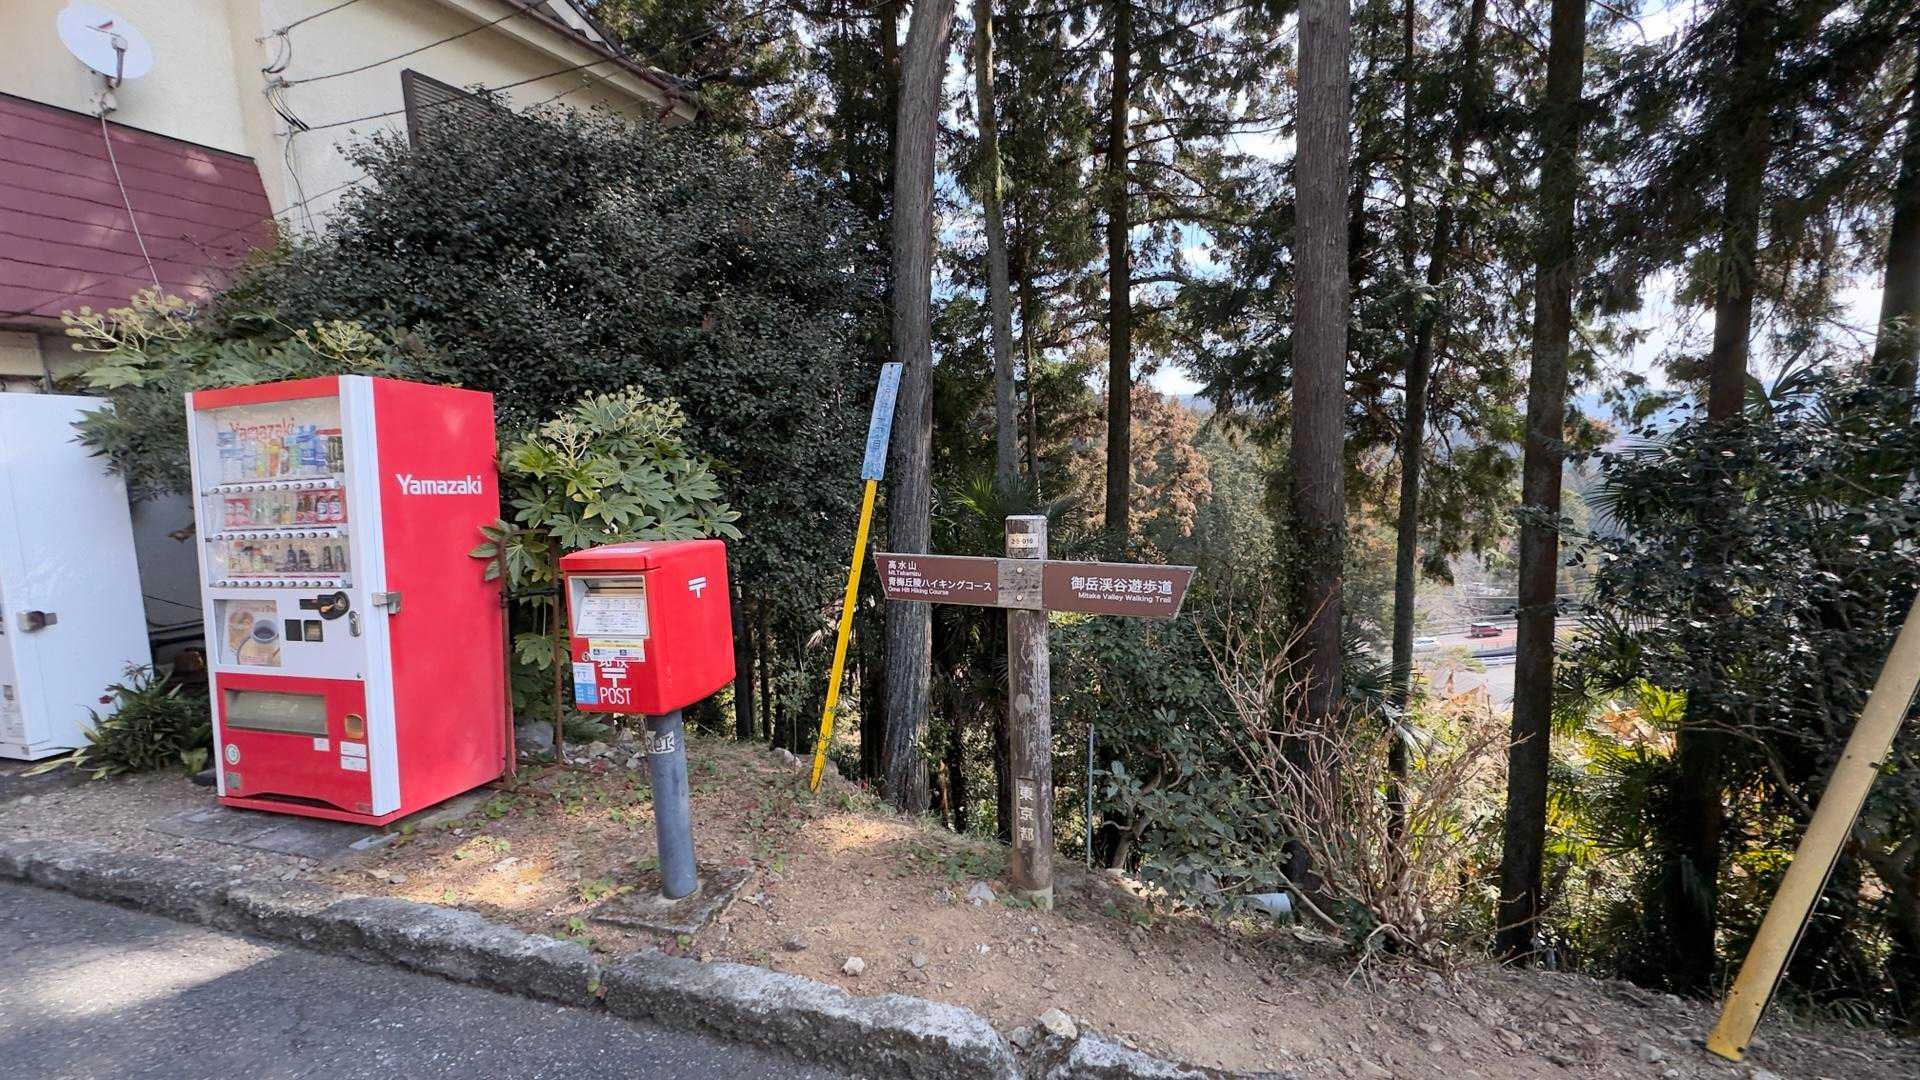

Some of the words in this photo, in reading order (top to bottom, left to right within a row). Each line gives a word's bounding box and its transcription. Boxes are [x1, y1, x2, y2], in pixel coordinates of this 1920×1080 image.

[395, 473, 482, 495] Yamazaki
[887, 560, 917, 570] 高水山
[888, 576, 992, 591] 青梅丘陵ハイキングコース
[1070, 575, 1173, 595] 御岳渓谷遊歩道
[928, 588, 949, 596] Course
[1078, 591, 1101, 600] Mitake
[1102, 593, 1124, 602] Valley
[1125, 594, 1153, 604] Walking
[1154, 595, 1172, 603] Trail
[600, 687, 632, 704] POST
[1019, 786, 1034, 841] 東京都
